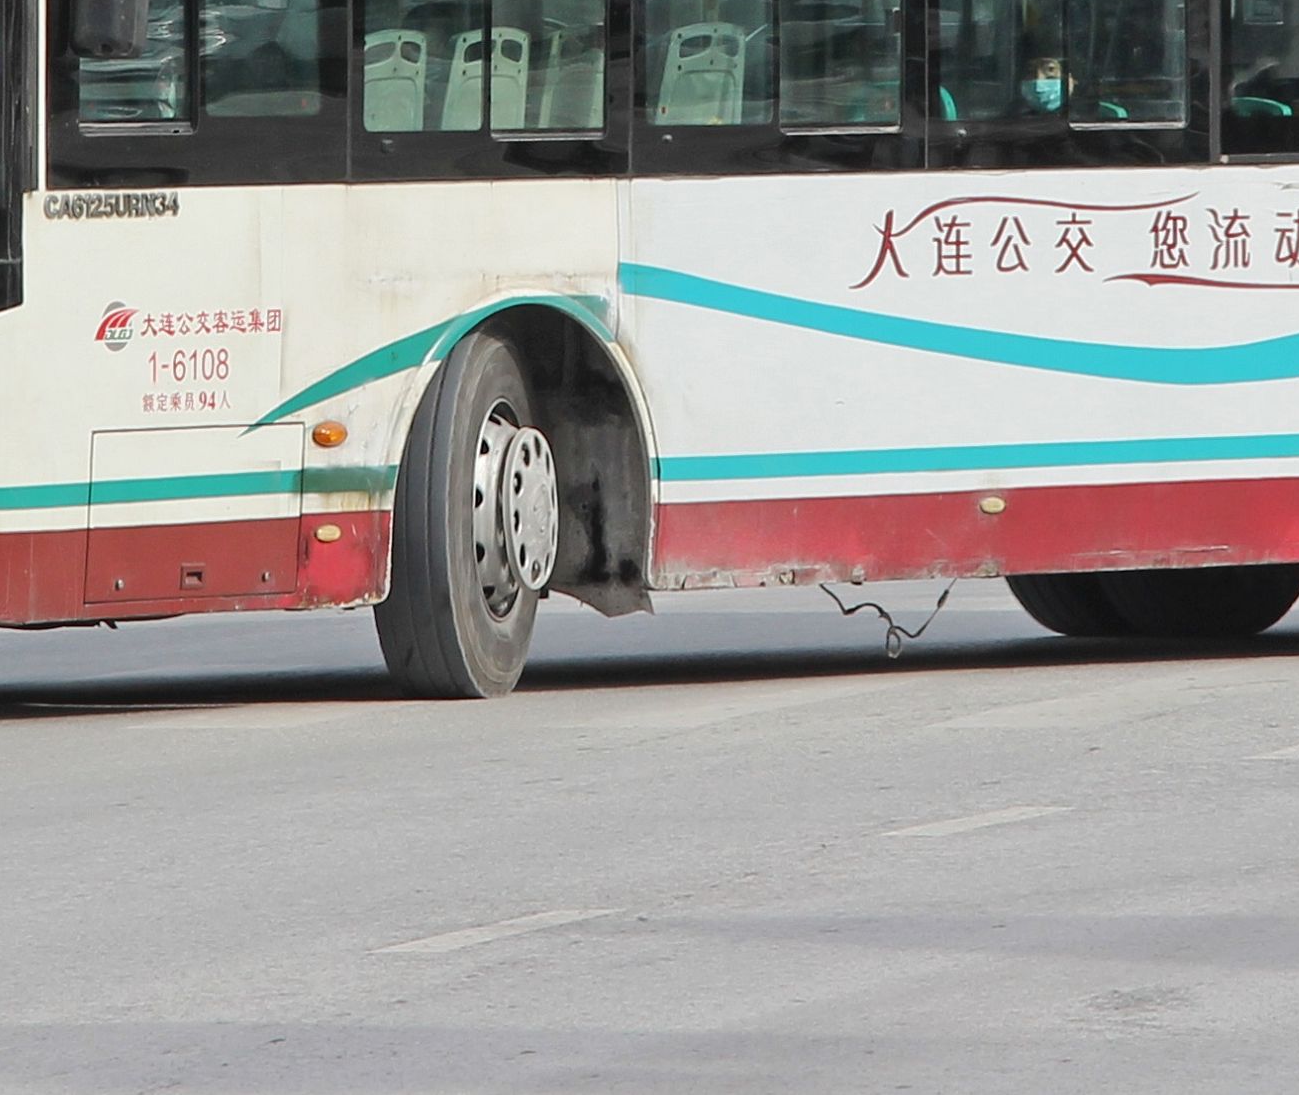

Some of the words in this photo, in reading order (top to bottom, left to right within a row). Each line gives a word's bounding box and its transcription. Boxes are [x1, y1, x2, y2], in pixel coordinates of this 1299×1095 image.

[849, 206, 1095, 289] 大连公交
[140, 308, 283, 337] 大连公交客运集团
[148, 347, 230, 383] 1-6108
